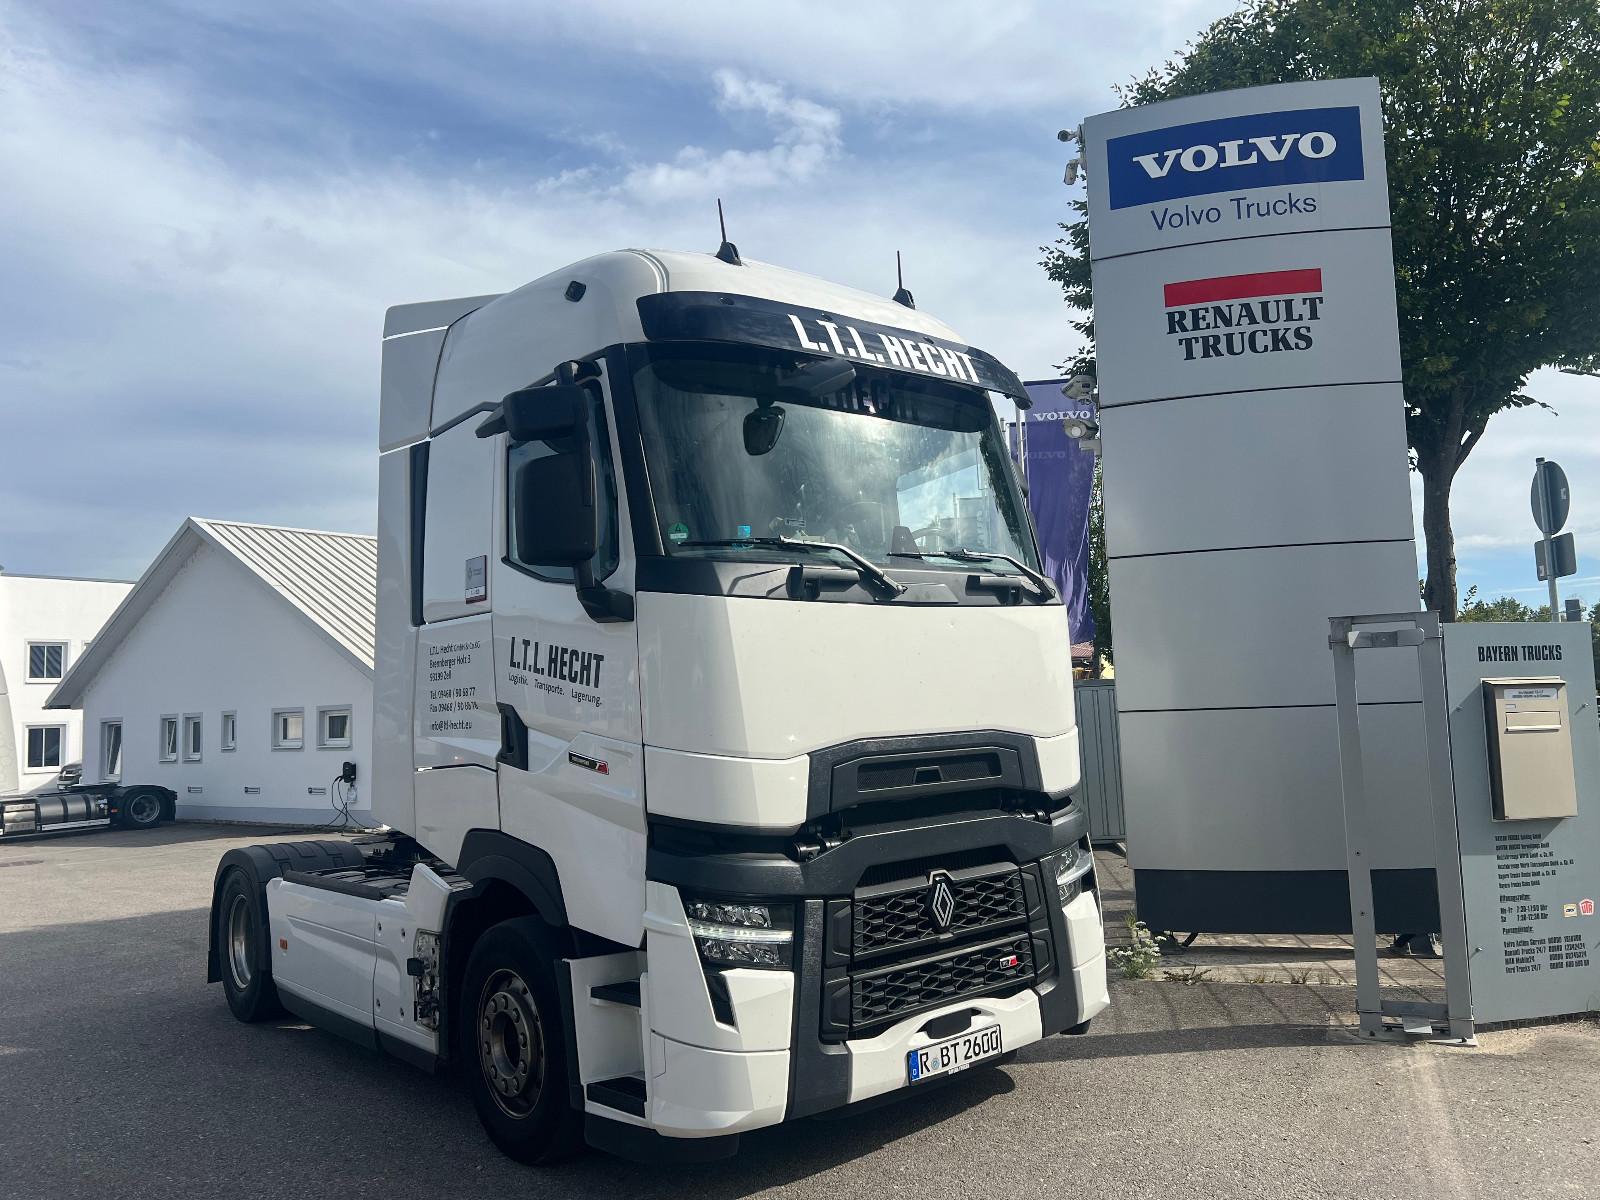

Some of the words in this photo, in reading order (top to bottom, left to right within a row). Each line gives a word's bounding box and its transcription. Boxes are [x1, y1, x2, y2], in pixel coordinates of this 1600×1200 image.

[1133, 132, 1337, 179] VOLVO
[1151, 205, 1221, 231] Volvo
[1230, 193, 1317, 220] Trucks
[1166, 297, 1324, 335] RENAULT
[787, 313, 886, 363] L.T.L.
[876, 332, 981, 384] HECHT
[1178, 326, 1313, 361] TRUCKS
[1033, 410, 1091, 422] VOLVO
[509, 636, 545, 676] L.T.L.
[547, 644, 605, 689] HECHT
[1477, 645, 1519, 662] BAYERN
[1521, 644, 1563, 661] TRUCKS
[534, 678, 565, 696] Transporte.
[571, 687, 603, 708] Lagerung.
[919, 1051, 931, 1075] R
[940, 1042, 960, 1068] BT
[963, 1030, 999, 1061] 2600
